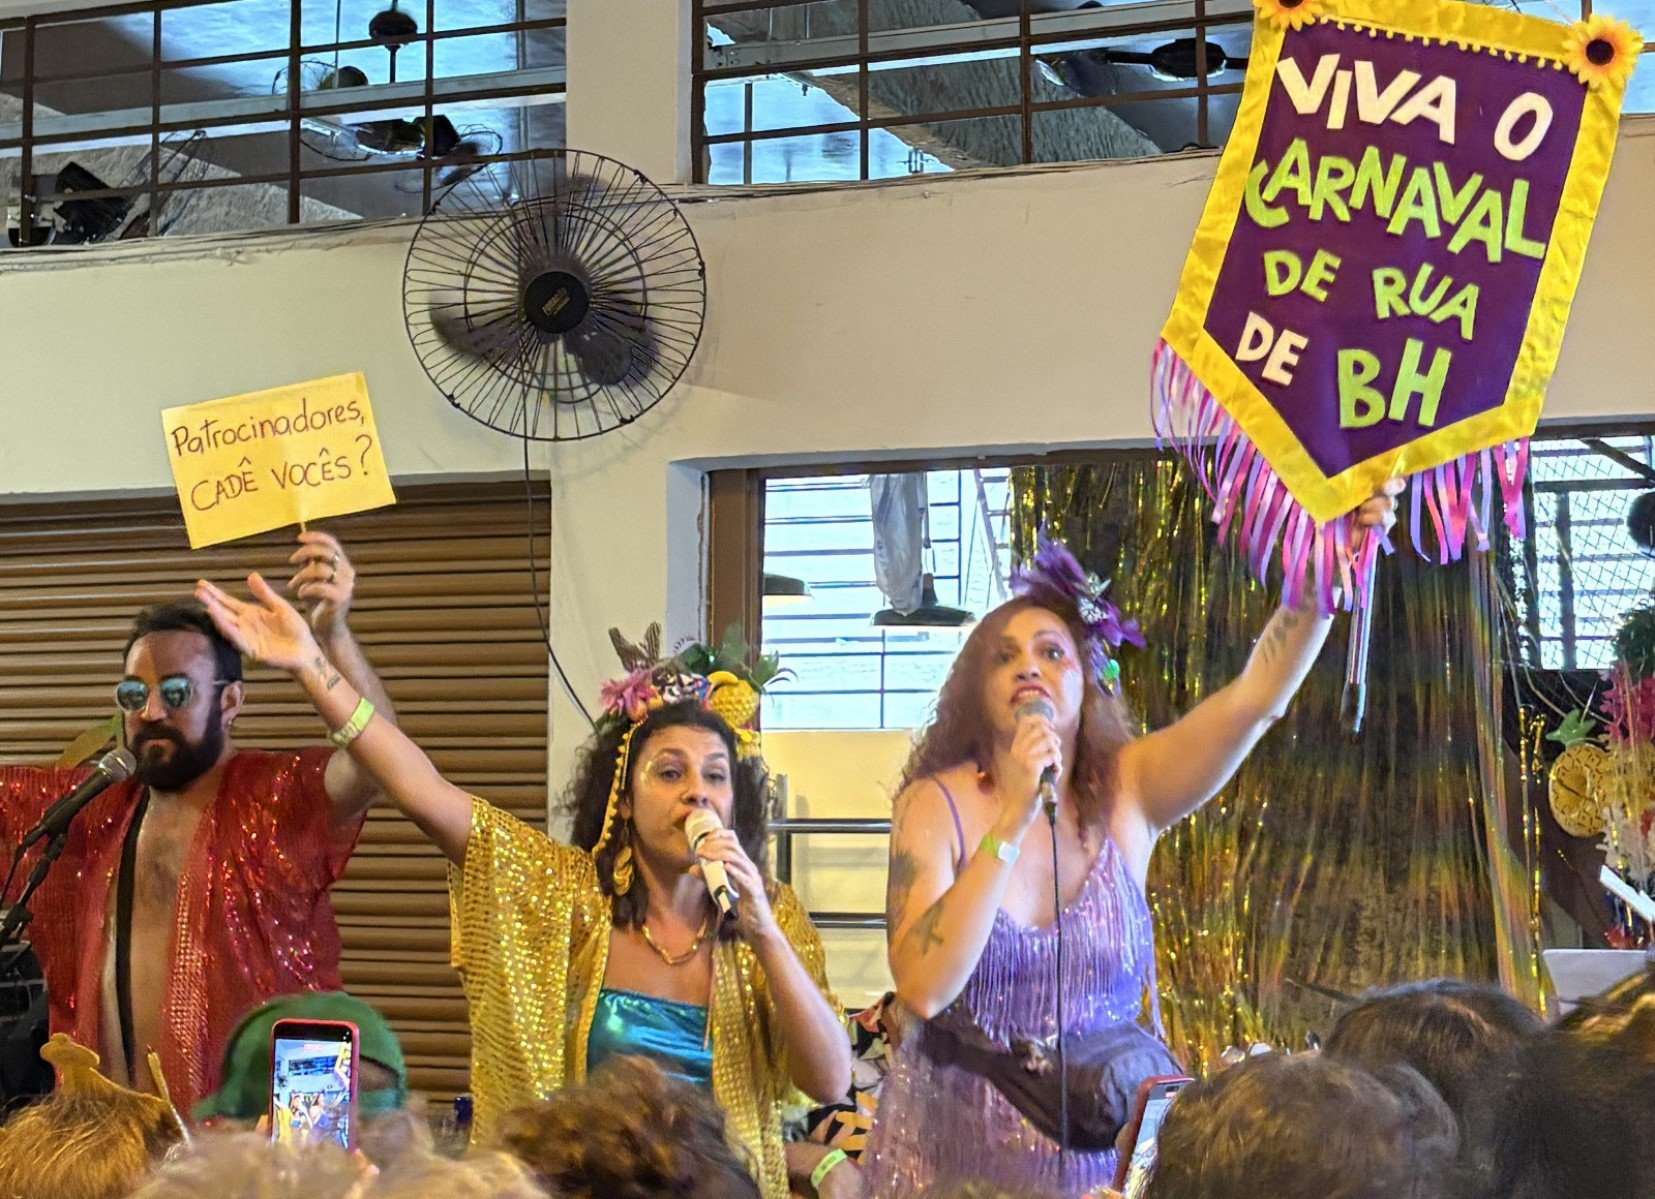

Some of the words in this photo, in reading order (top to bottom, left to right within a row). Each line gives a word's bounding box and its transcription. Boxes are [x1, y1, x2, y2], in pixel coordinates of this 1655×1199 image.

[1277, 54, 1457, 145] VIVA
[1494, 92, 1554, 161] O
[1245, 138, 1545, 263] CARNAVAL
[1264, 249, 1341, 302] DE
[1373, 262, 1480, 341] RUA
[1235, 312, 1308, 386] DE
[1337, 339, 1452, 430] BH
[171, 398, 365, 457] Patrocinadores,
[191, 456, 258, 511] CADÊ
